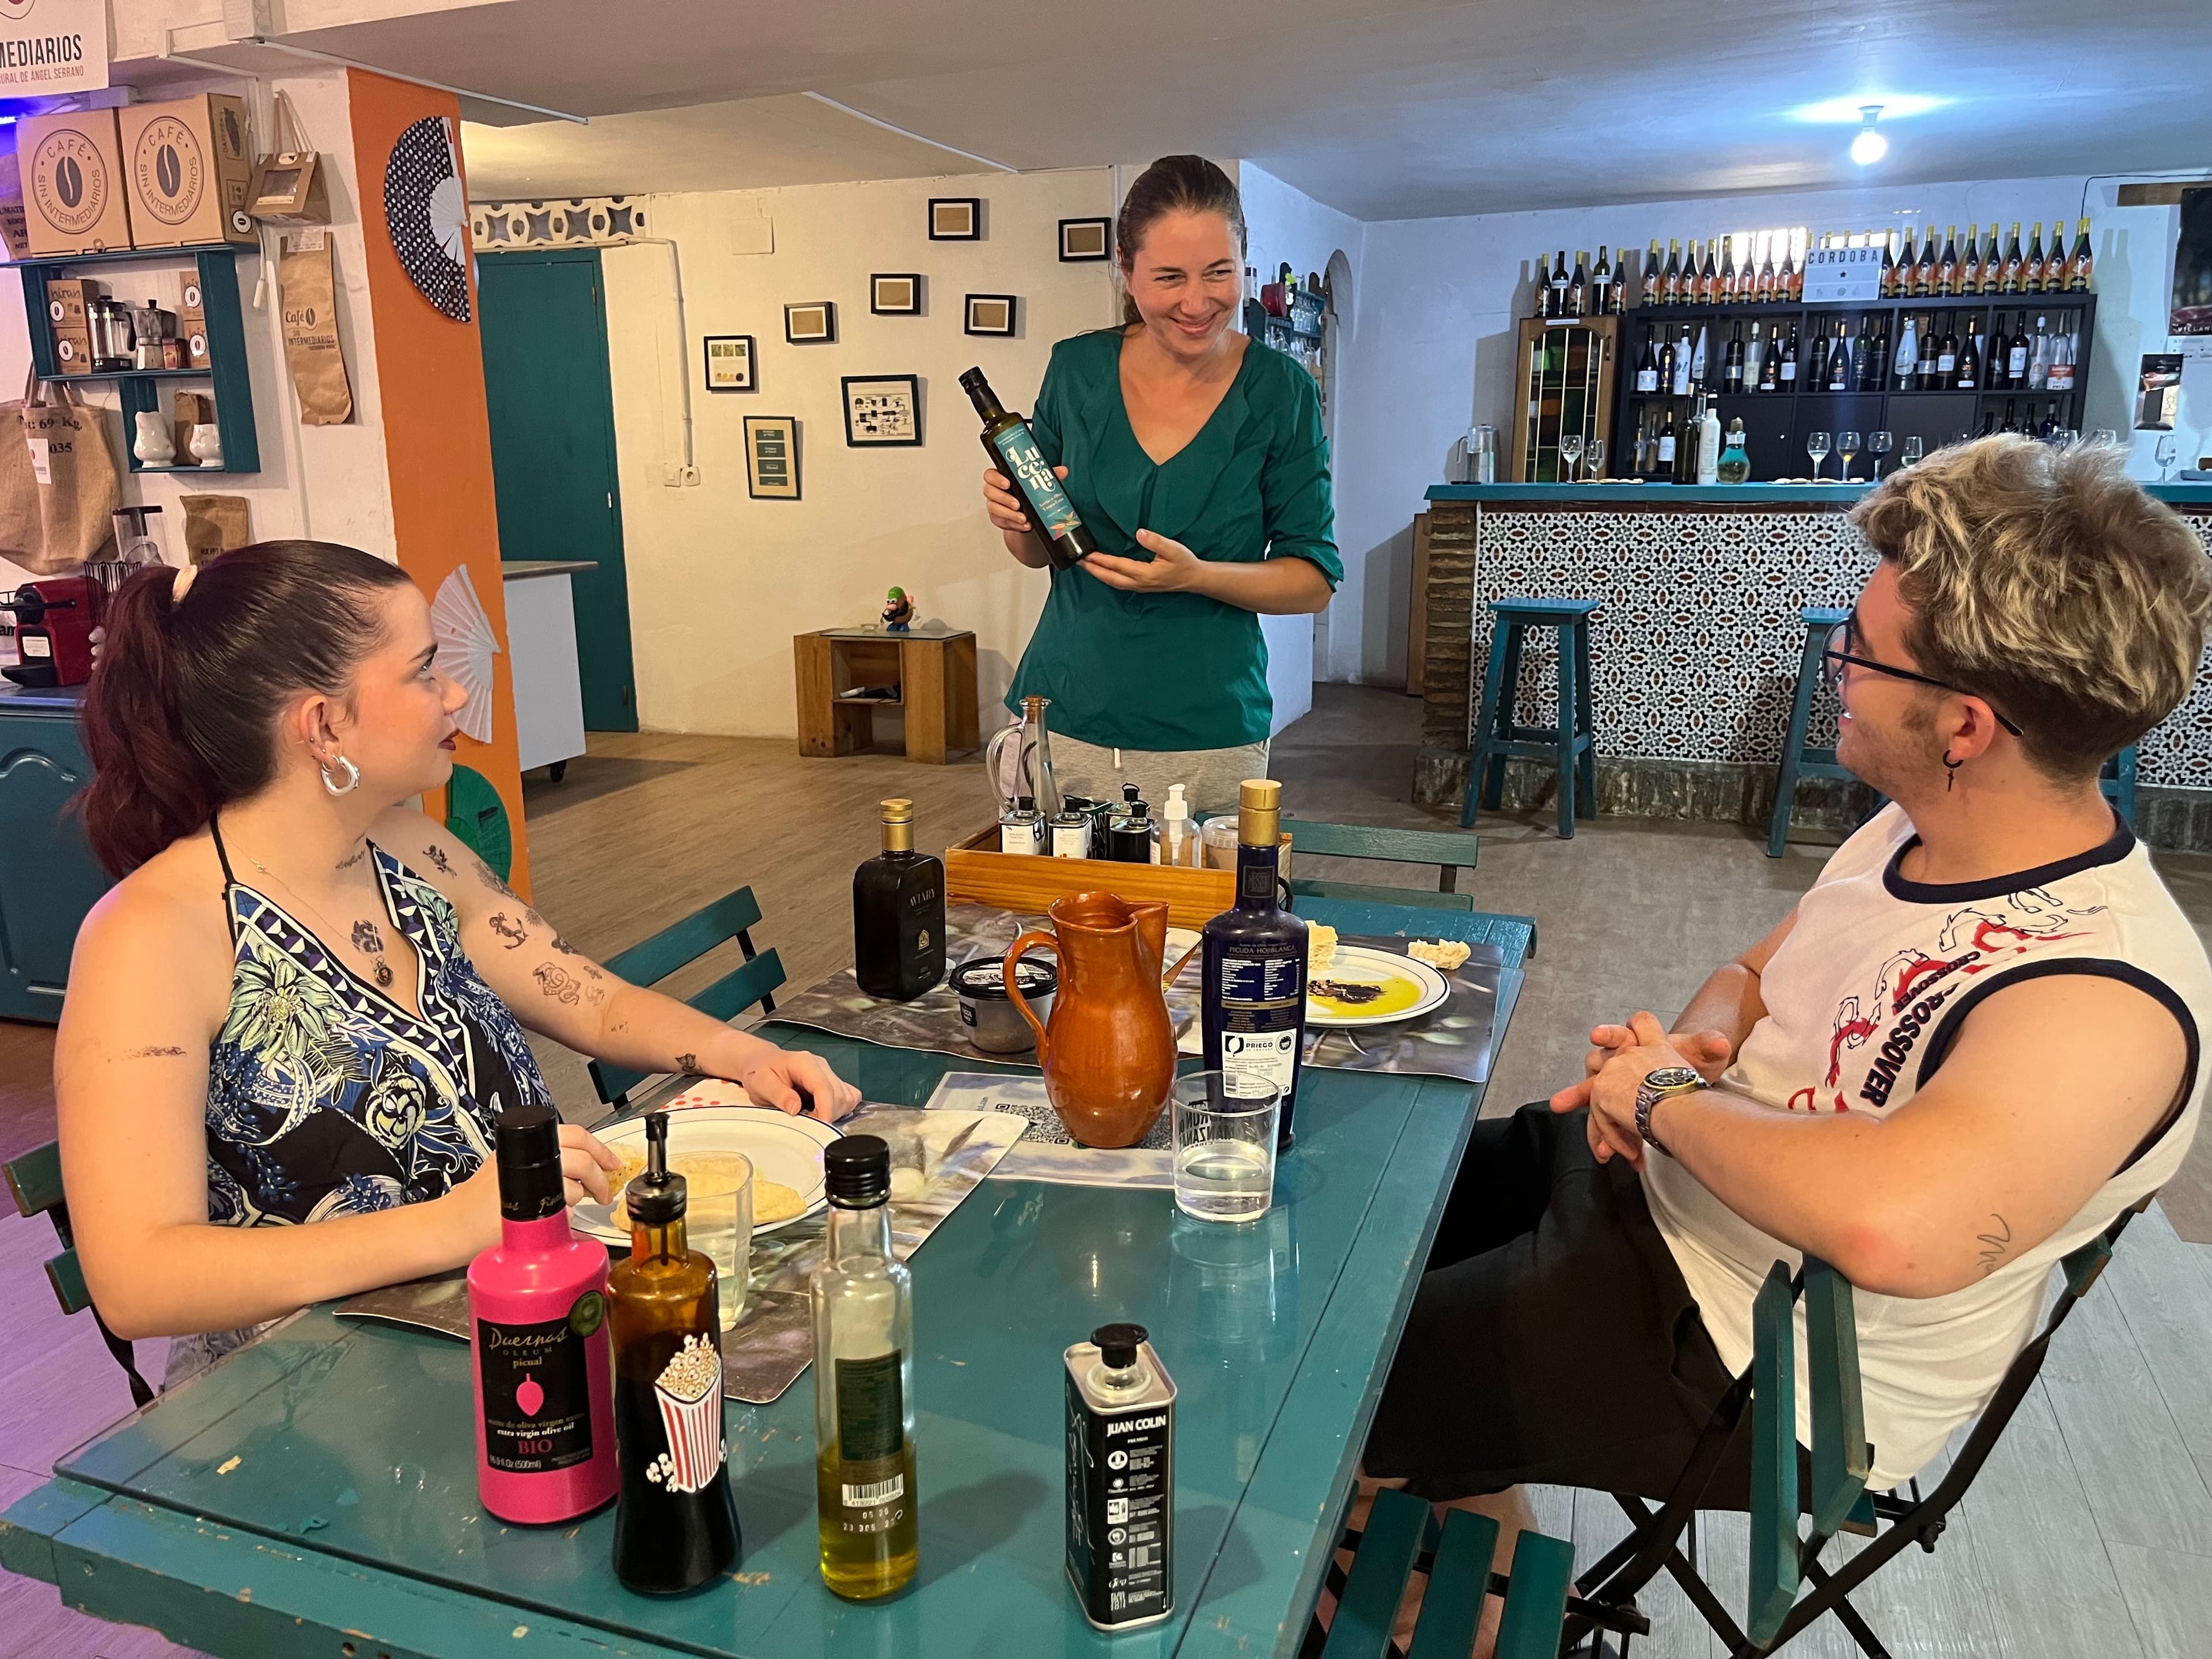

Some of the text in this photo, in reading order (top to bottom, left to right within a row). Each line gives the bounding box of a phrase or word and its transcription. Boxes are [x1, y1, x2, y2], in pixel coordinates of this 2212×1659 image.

[0, 71, 18, 84] URAL
[20, 70, 29, 82] DE
[54, 65, 84, 79] SERRANO
[148, 126, 184, 146] CAFÉ
[47, 139, 86, 158] CAFÉ
[140, 156, 198, 215] SIN INTERMEDIARIOS
[38, 169, 101, 225] SIN INTERMEDIARIOS
[1808, 250, 1878, 264] CORDOBA
[286, 309, 305, 326] Café
[39, 418, 54, 429] 69
[1891, 950, 1981, 1013] CROSSOVER
[503, 1347, 552, 1356] OLEUM
[513, 1356, 542, 1369] picual
[497, 1422, 574, 1439] extra virgin olive oil
[1107, 1414, 1166, 1437] JUAN COLIN
[518, 1439, 553, 1454] BIO
